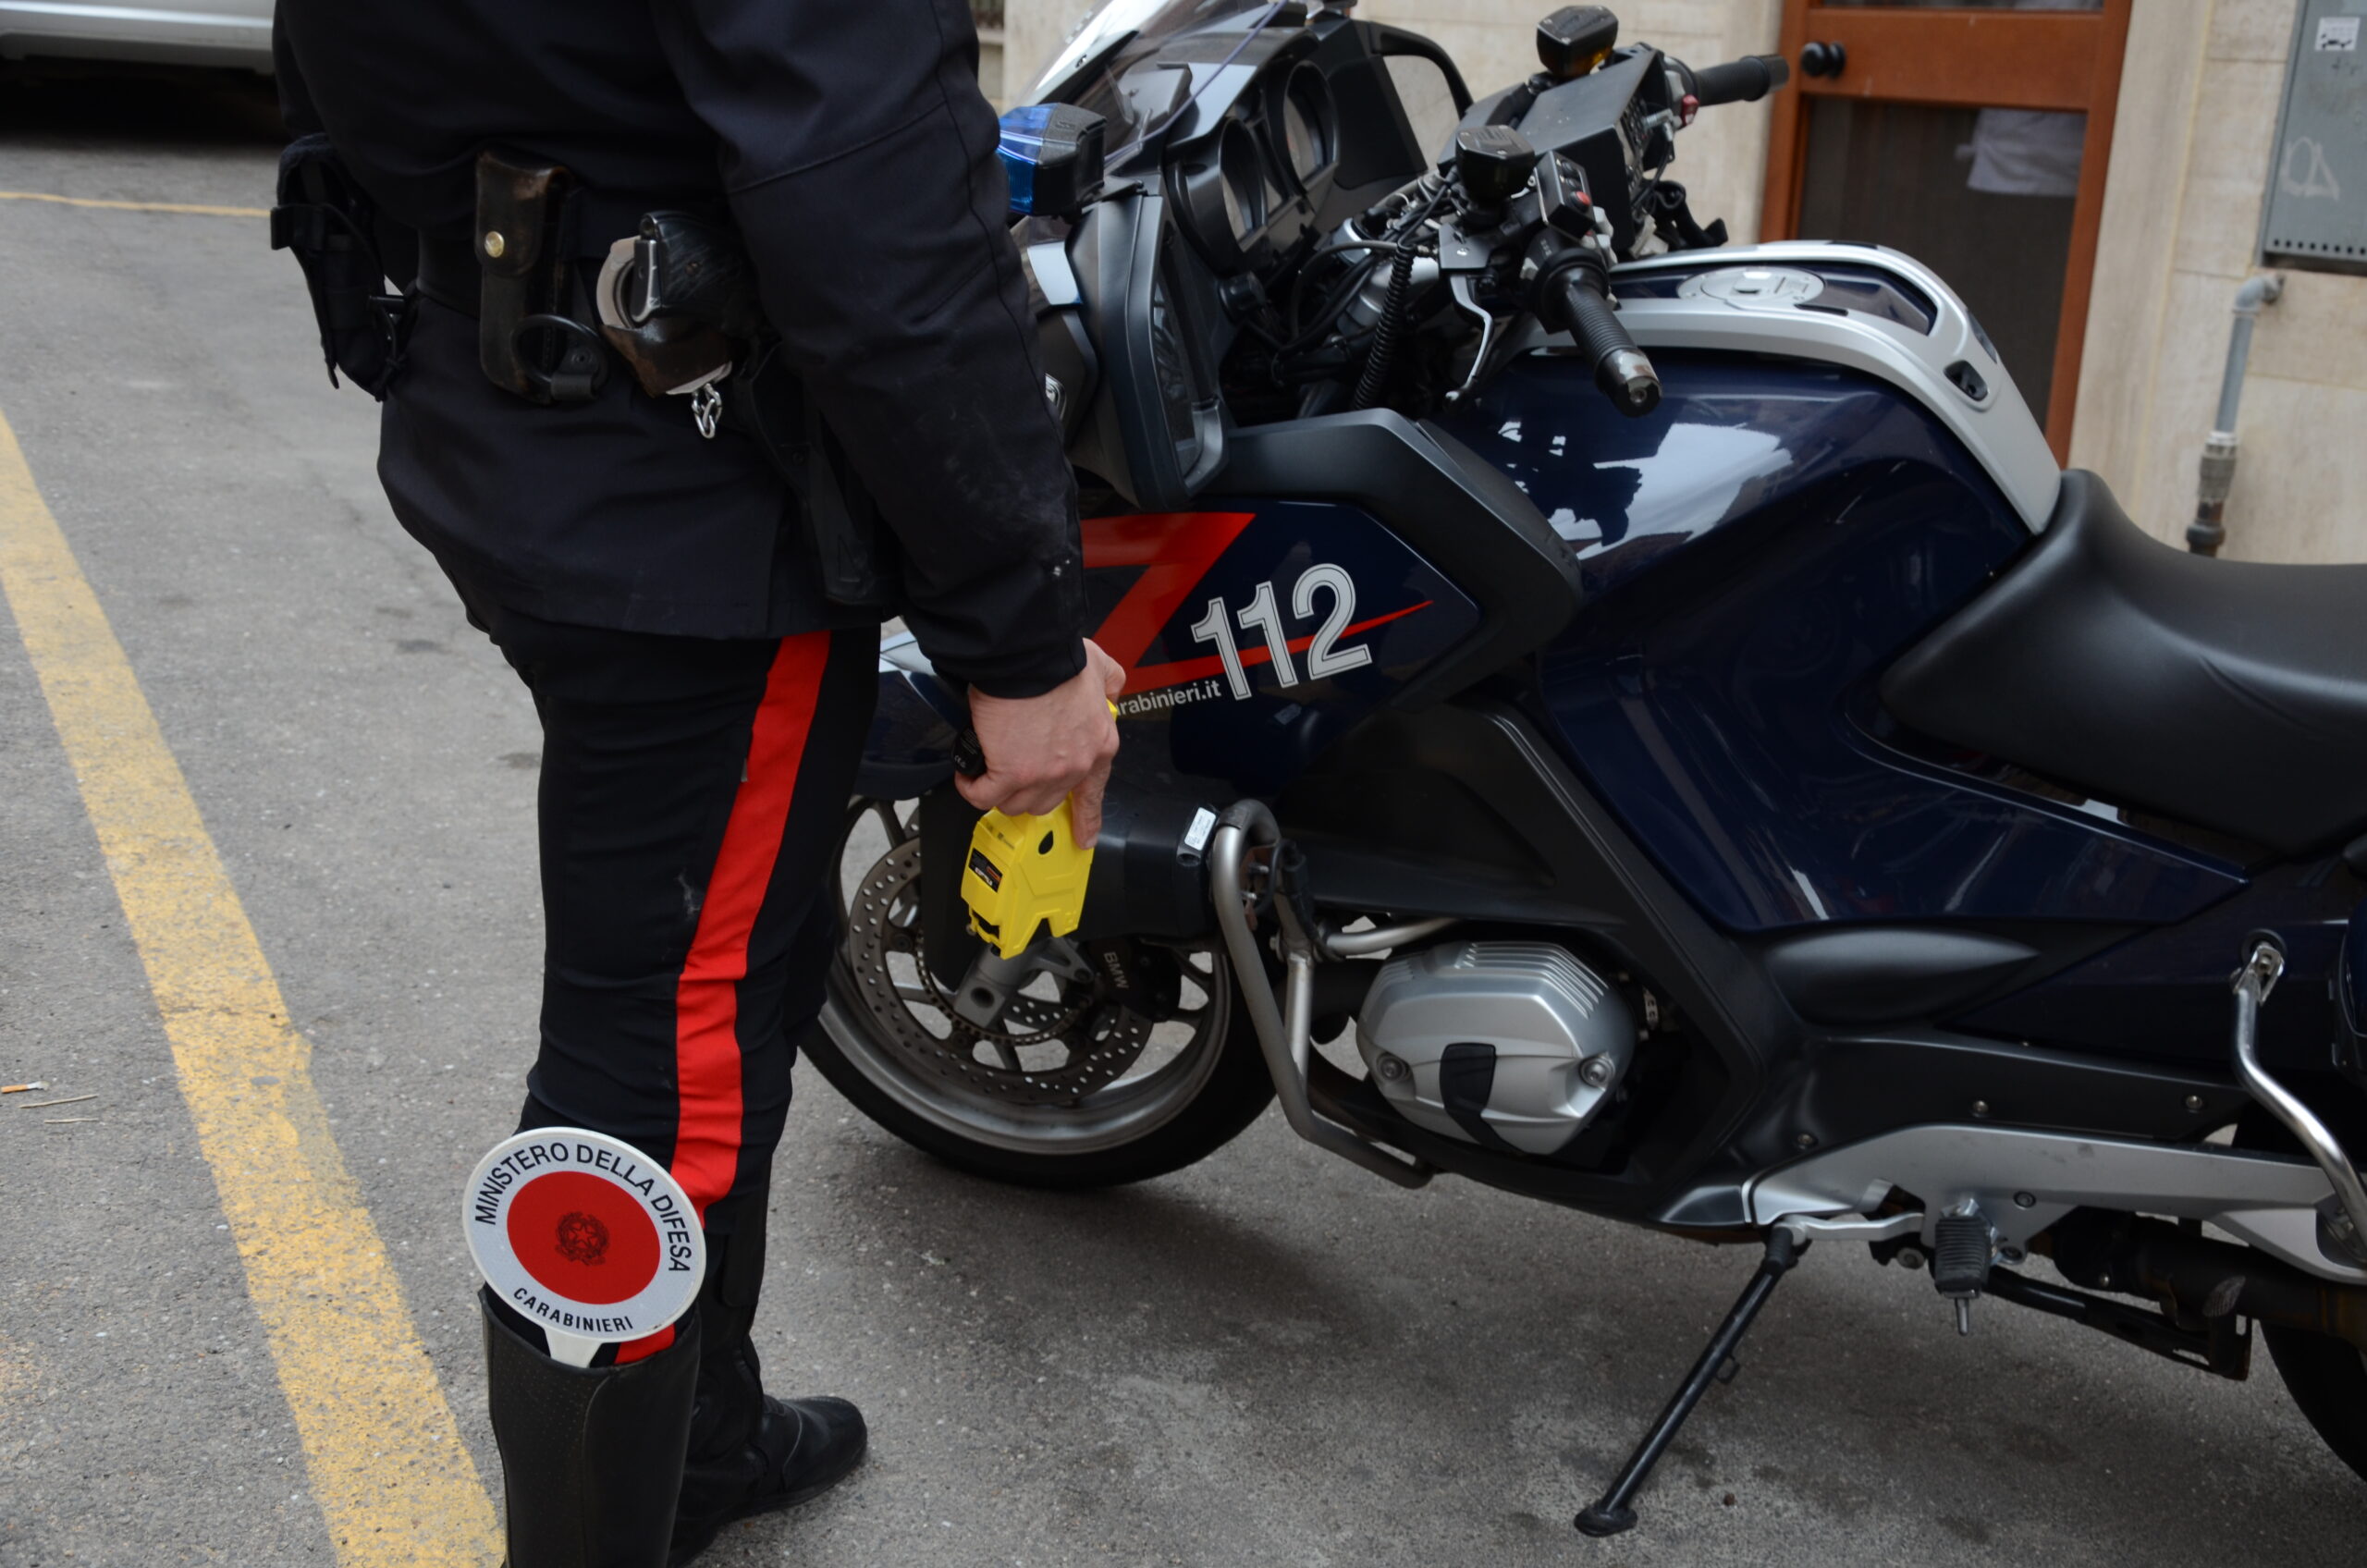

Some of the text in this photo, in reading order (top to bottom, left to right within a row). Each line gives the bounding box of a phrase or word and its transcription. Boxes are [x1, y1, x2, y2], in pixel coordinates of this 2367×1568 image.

[1190, 563, 1373, 701] 112
[1103, 951, 1130, 988] BMW
[474, 1142, 693, 1273] MINISTERO DELLA DIFESA
[513, 1287, 633, 1333] CARABINIERI
